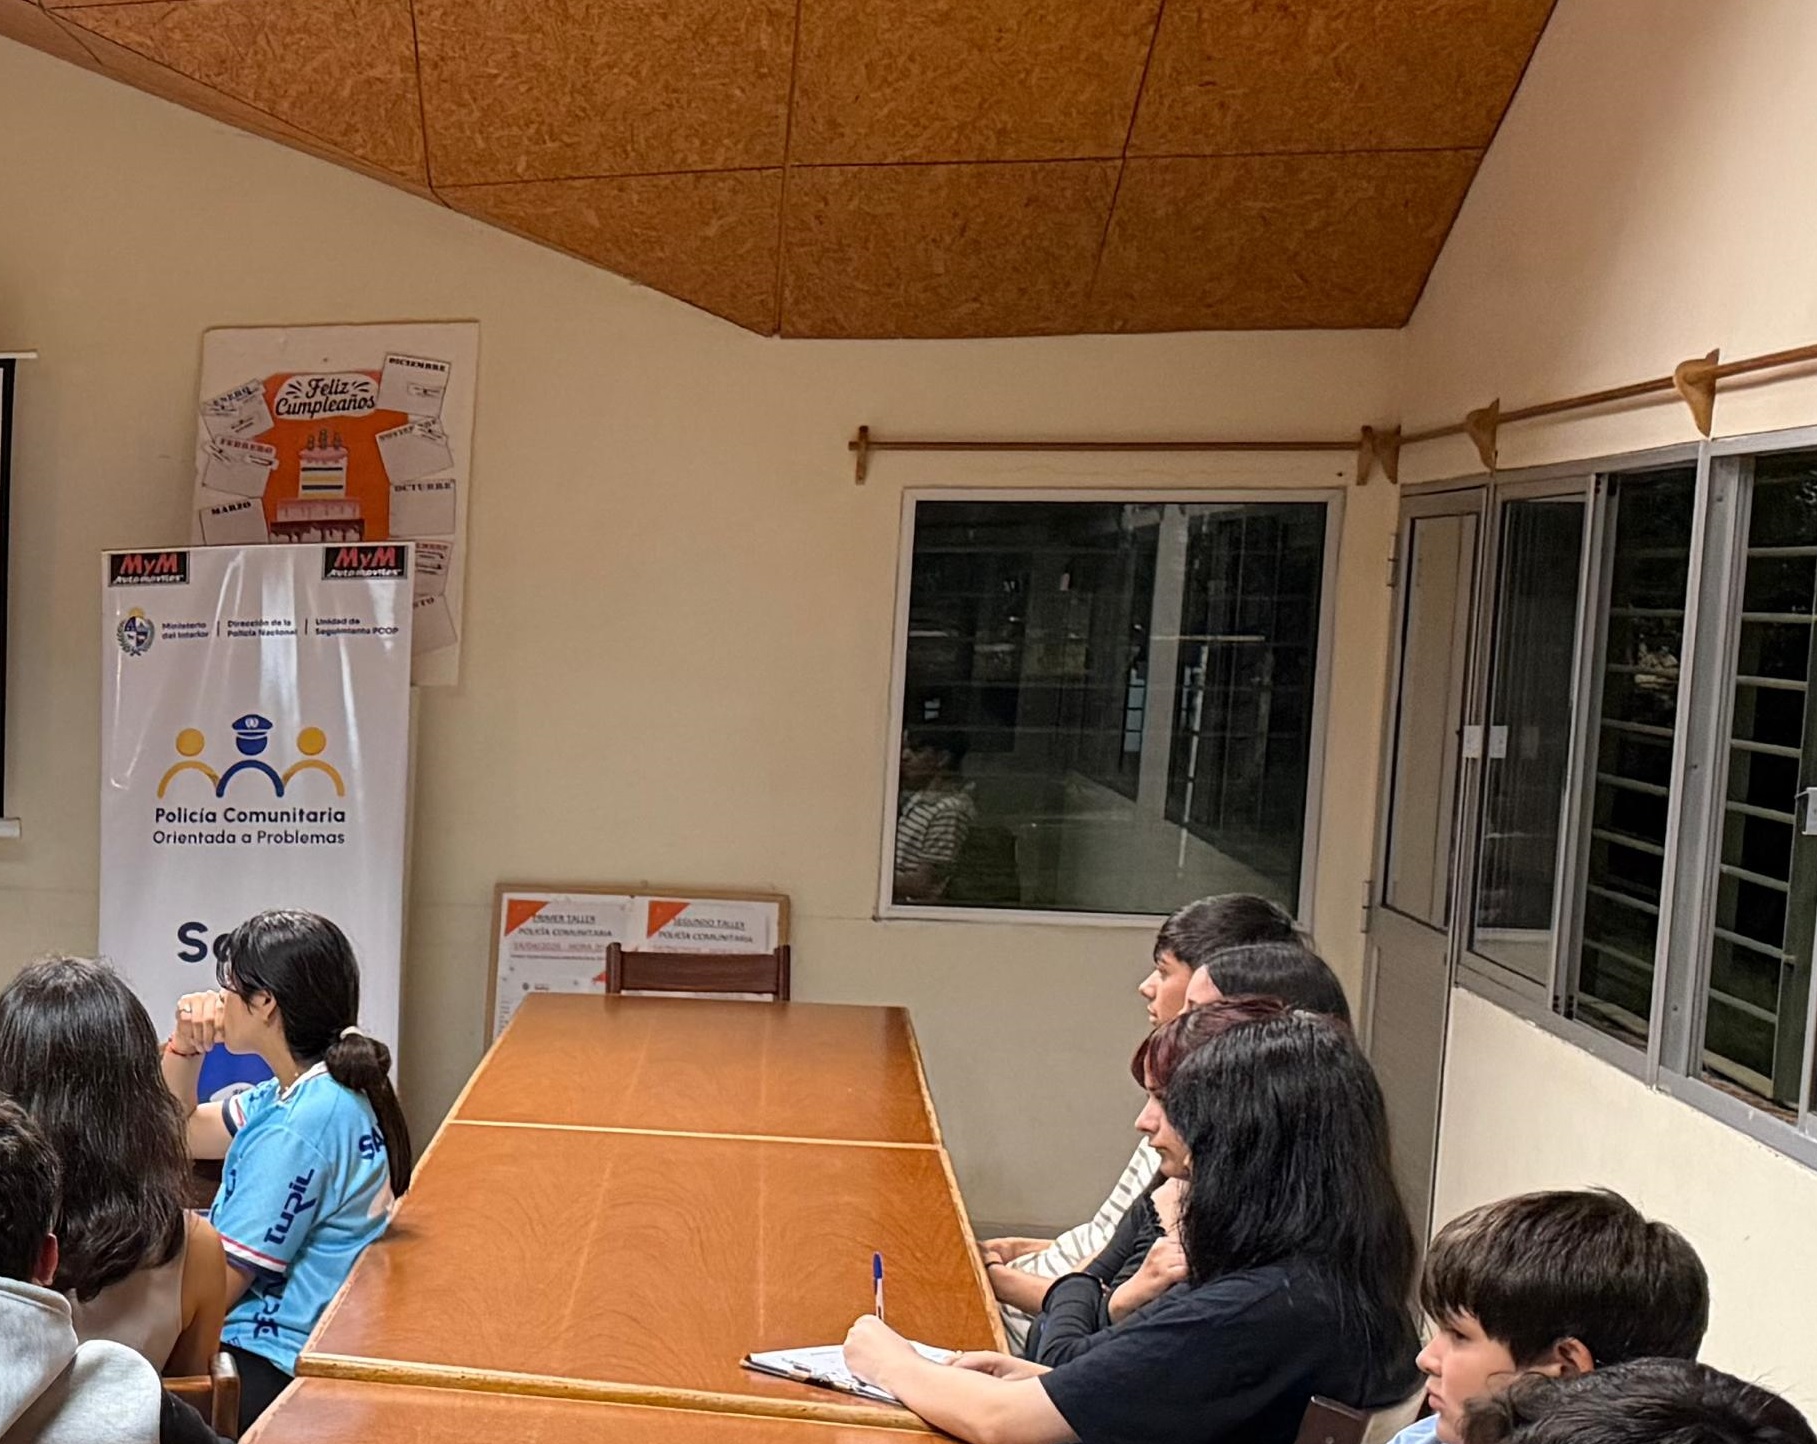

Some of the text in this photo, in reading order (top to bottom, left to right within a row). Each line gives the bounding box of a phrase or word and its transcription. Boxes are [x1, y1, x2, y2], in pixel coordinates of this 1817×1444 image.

[305, 378, 349, 399] Feliz
[275, 394, 375, 418] Cumpleaños
[211, 501, 252, 515] MARZO
[120, 553, 178, 575] MyM
[334, 546, 397, 568] MyM
[162, 622, 207, 630] Ministerio
[155, 807, 346, 823] Policía Comunitaria
[153, 830, 345, 844] Orientada a Problemas
